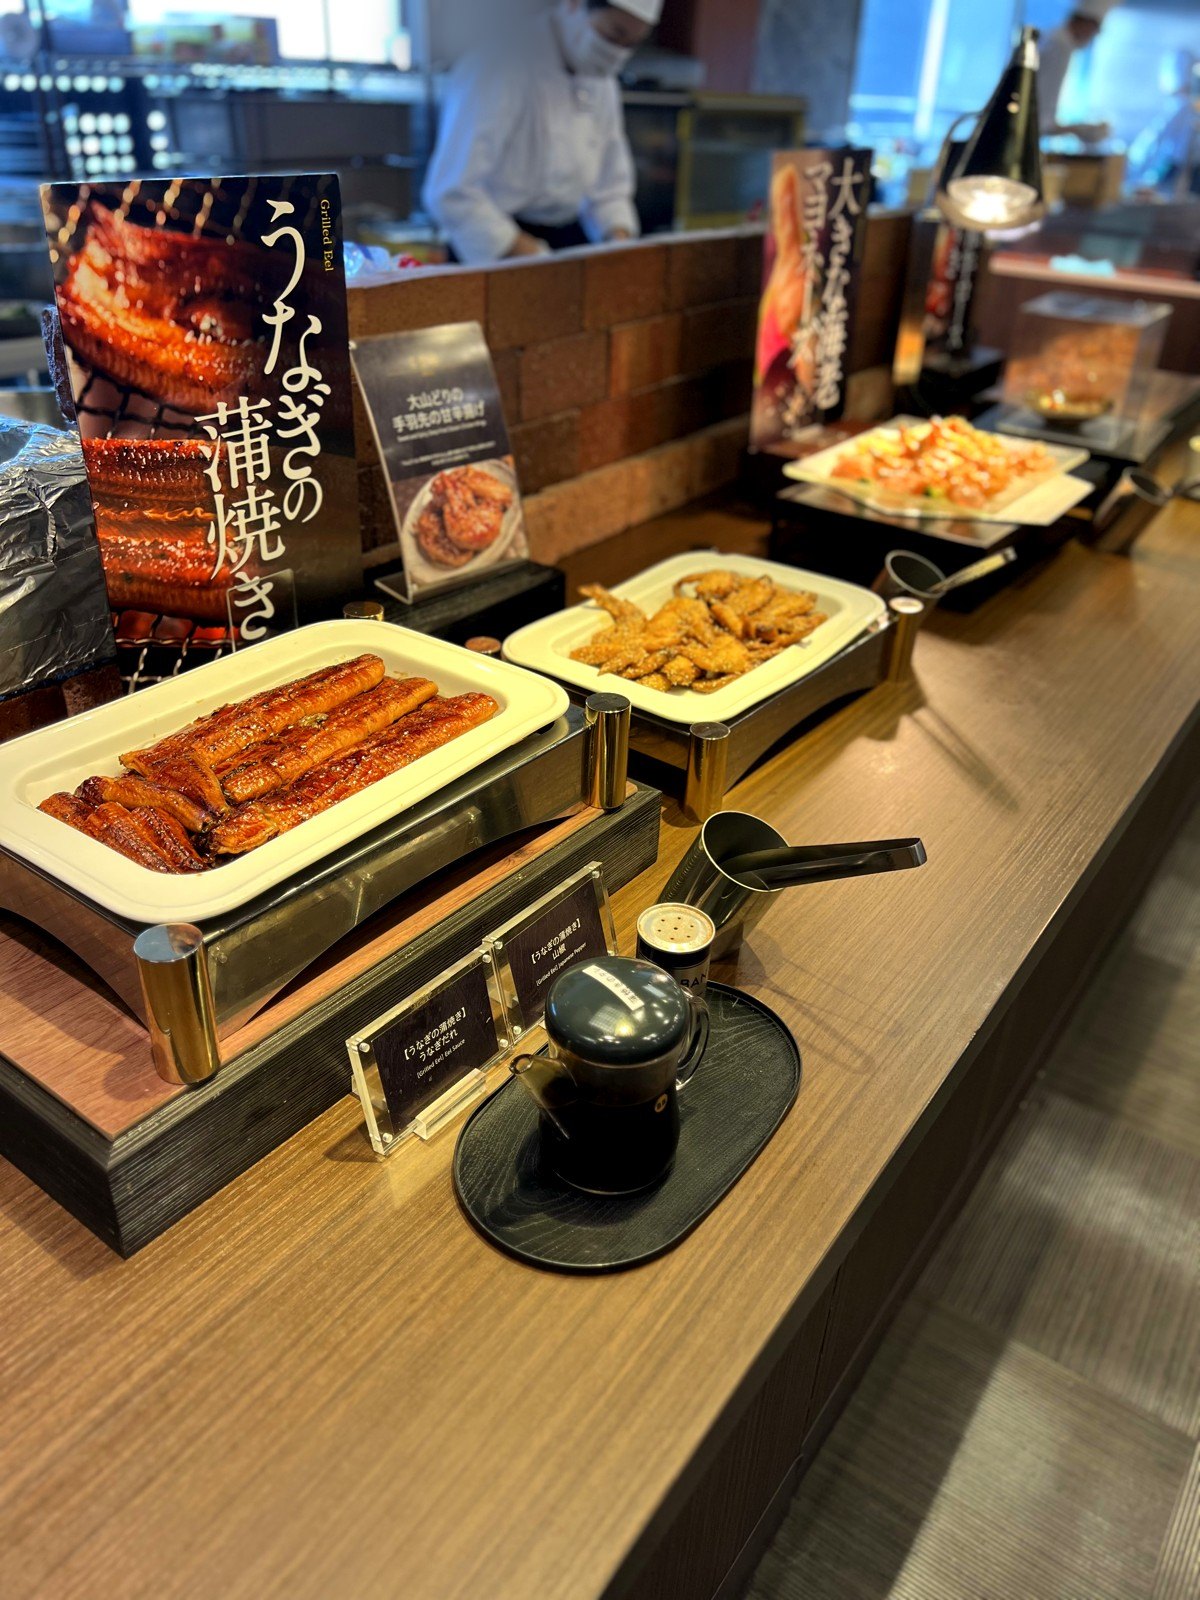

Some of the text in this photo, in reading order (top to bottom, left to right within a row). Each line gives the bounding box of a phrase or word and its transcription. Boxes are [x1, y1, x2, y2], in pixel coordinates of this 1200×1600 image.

[320, 199, 335, 272] Grilled Eel
[260, 199, 332, 523] うなぎの
[405, 387, 464, 411] 大山どりの
[193, 396, 286, 640] 蒲焼き
[552, 943, 567, 960] 山椒
[419, 1029, 459, 1062] うなぎだれ
